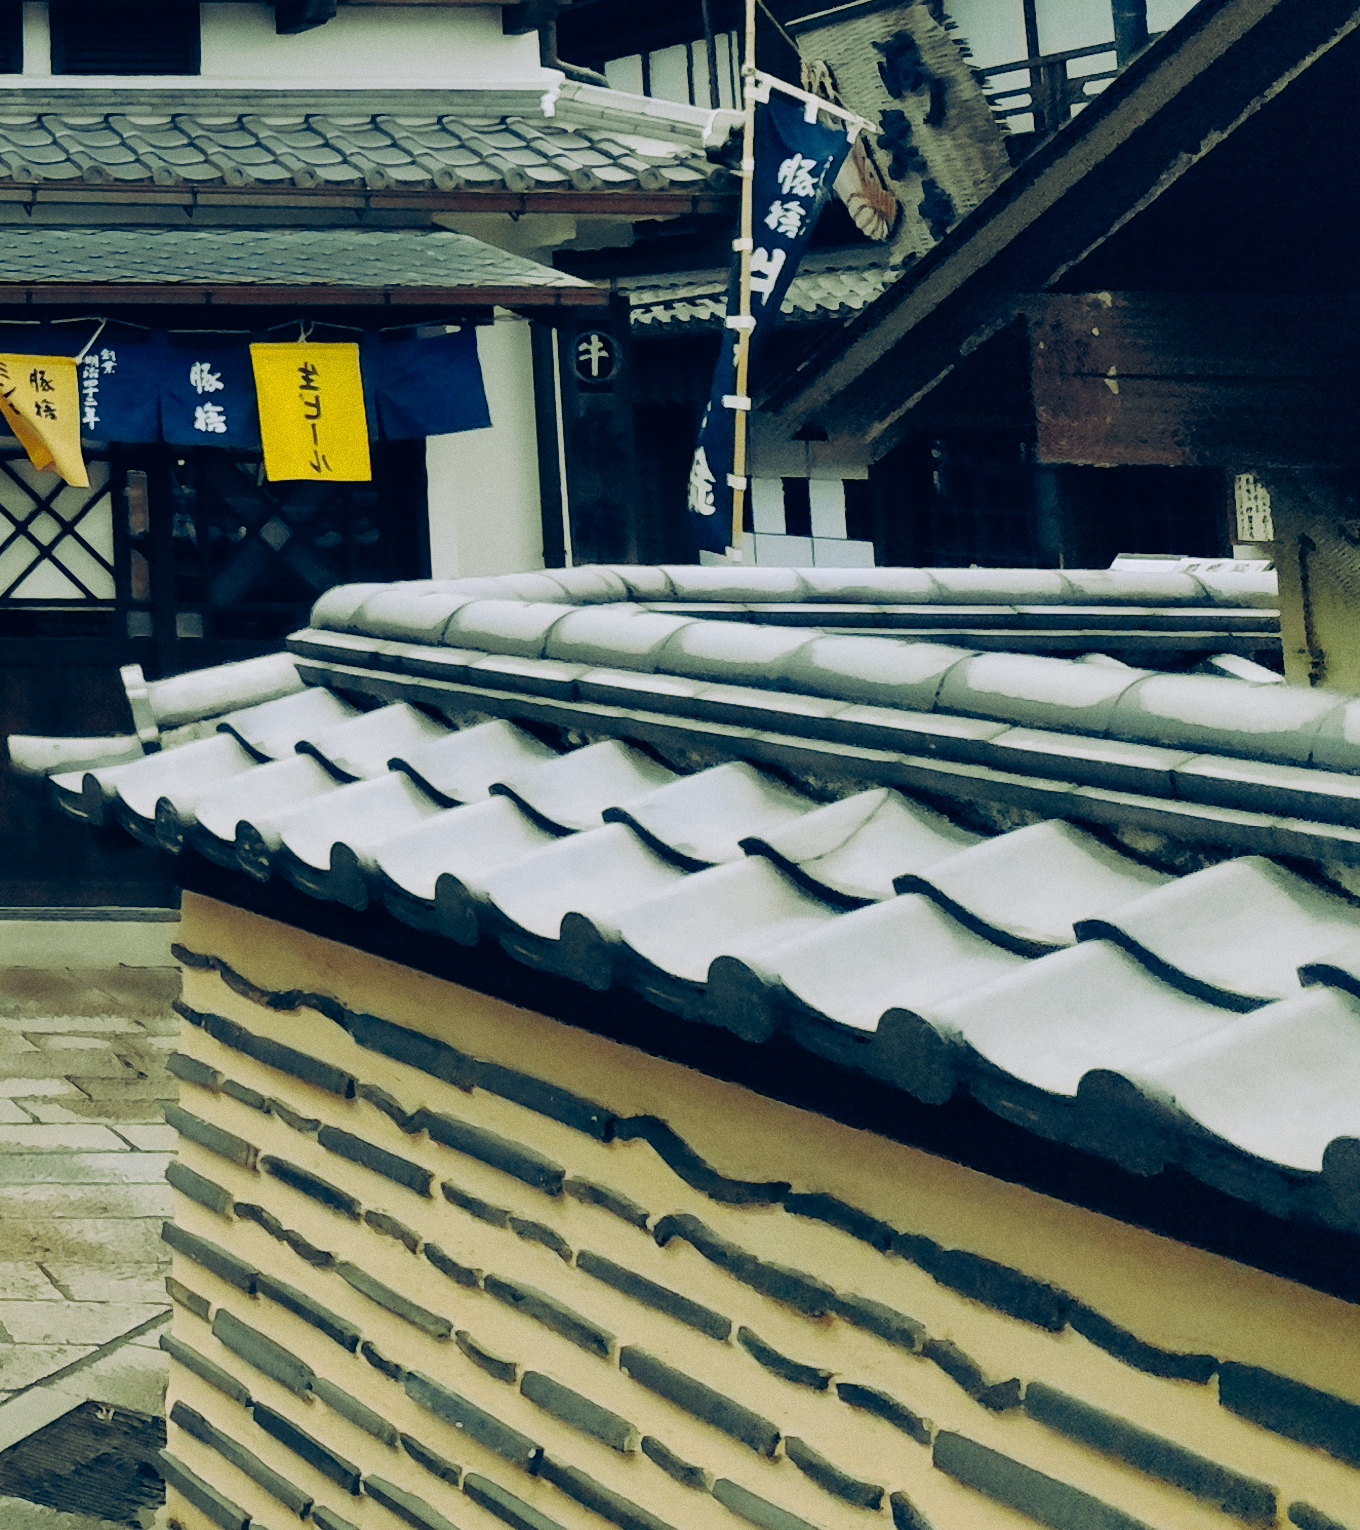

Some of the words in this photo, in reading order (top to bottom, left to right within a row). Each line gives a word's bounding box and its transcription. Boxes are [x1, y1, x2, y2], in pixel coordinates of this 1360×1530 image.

[764, 153, 818, 239] 豚捨
[578, 334, 610, 377] 牛
[29, 368, 58, 421] 豚捨
[82, 355, 101, 430] 明治四十二年
[190, 361, 228, 434] 豚捨
